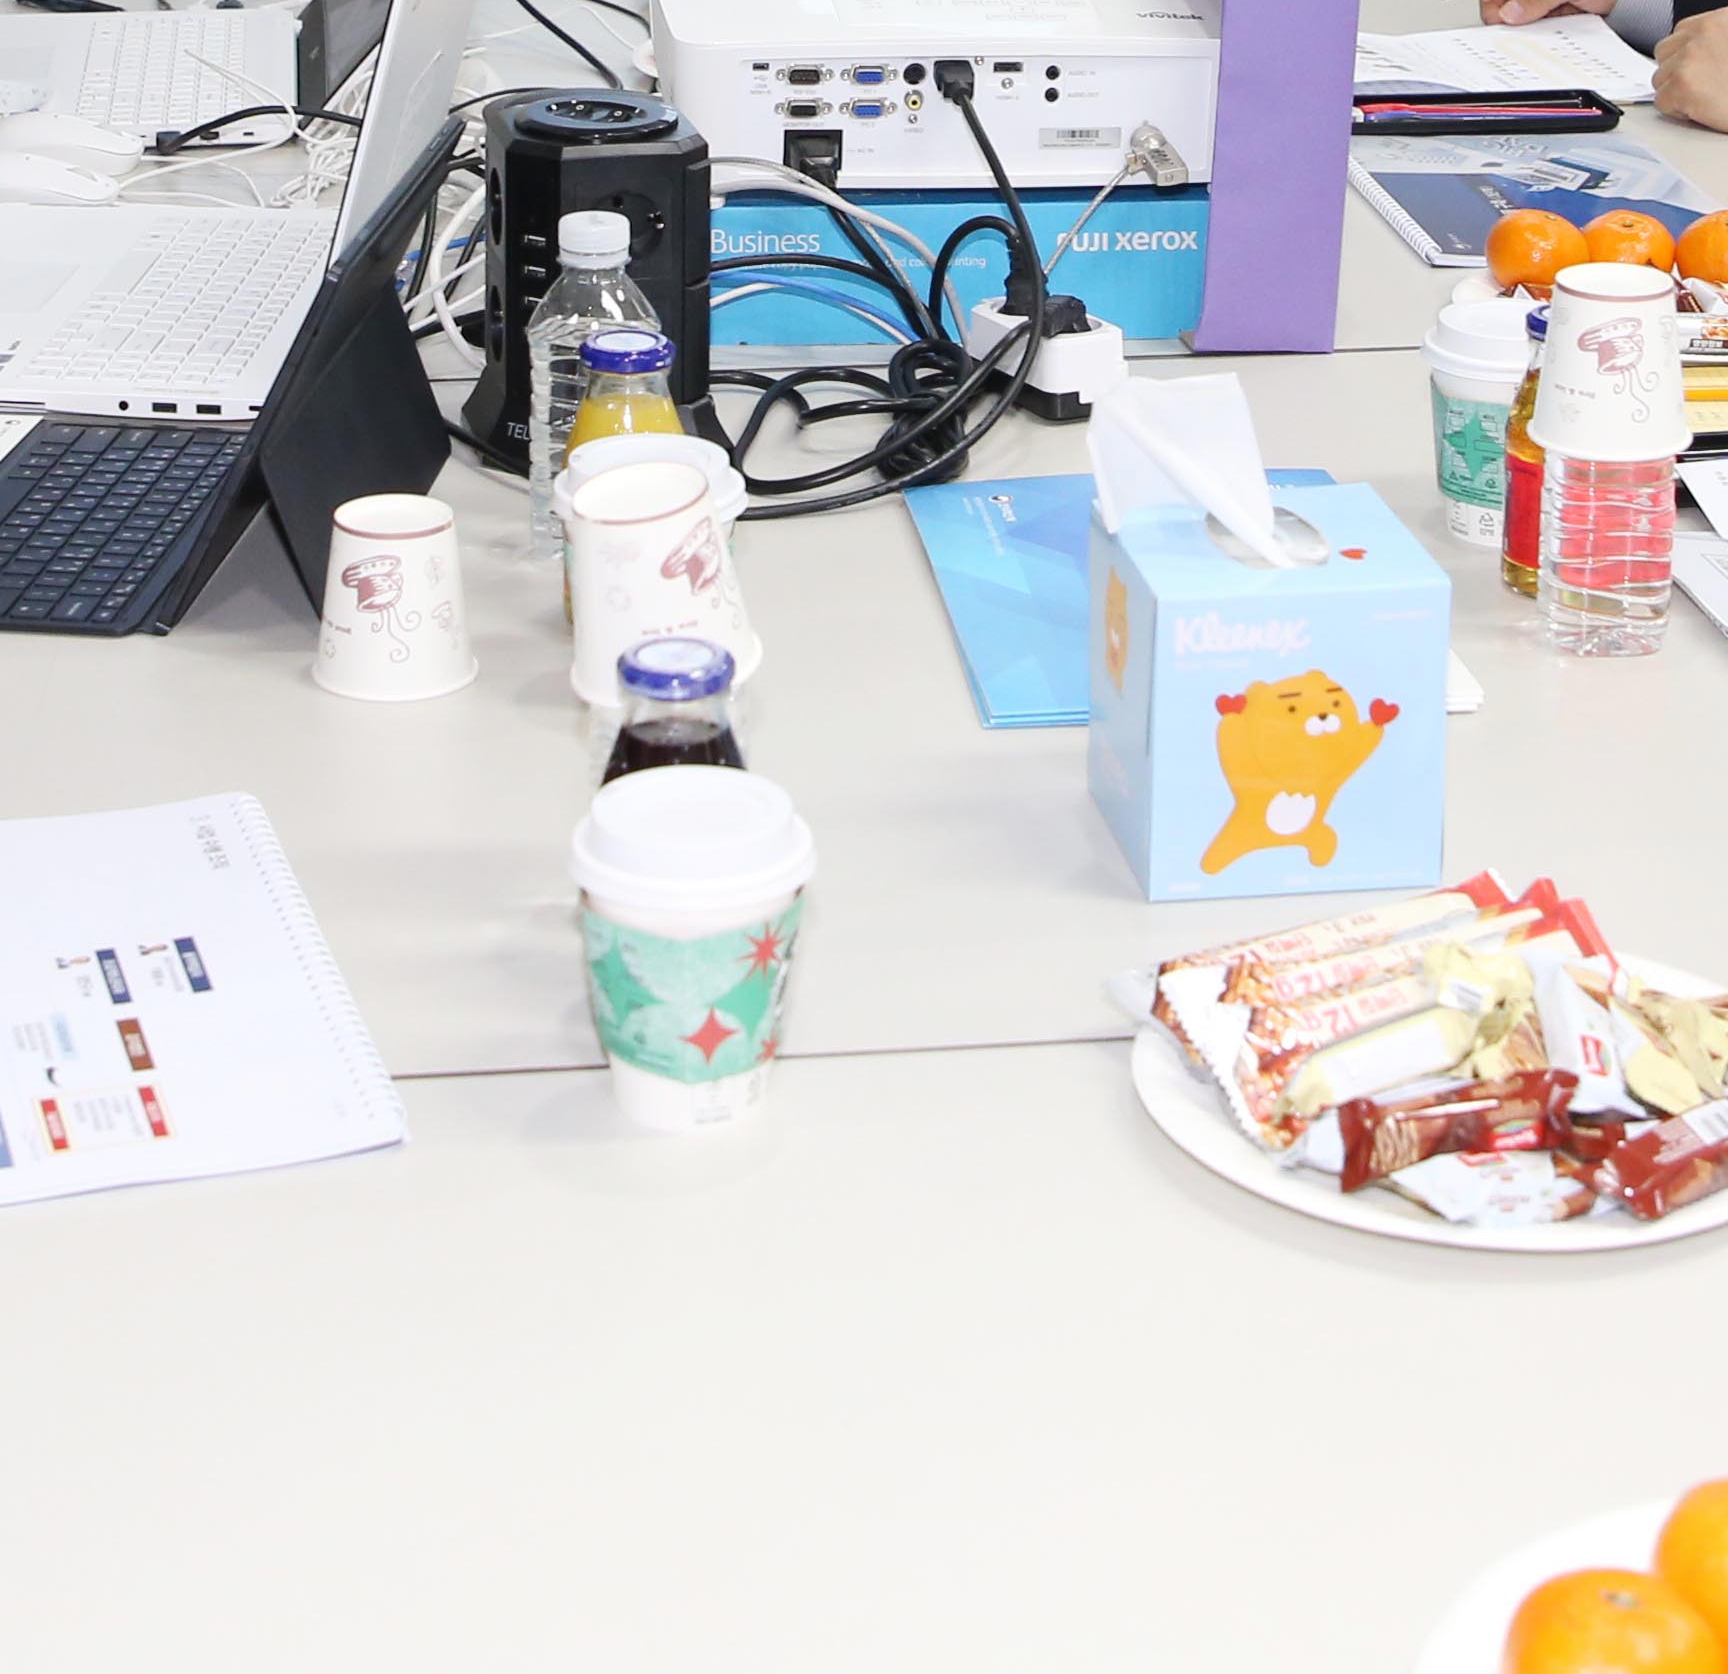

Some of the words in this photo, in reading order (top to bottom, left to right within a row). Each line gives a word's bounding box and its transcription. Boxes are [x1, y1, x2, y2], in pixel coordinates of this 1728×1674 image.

[711, 229, 820, 254] Business
[1115, 230, 1199, 252] xerox
[1175, 610, 1311, 657] Kleenex
